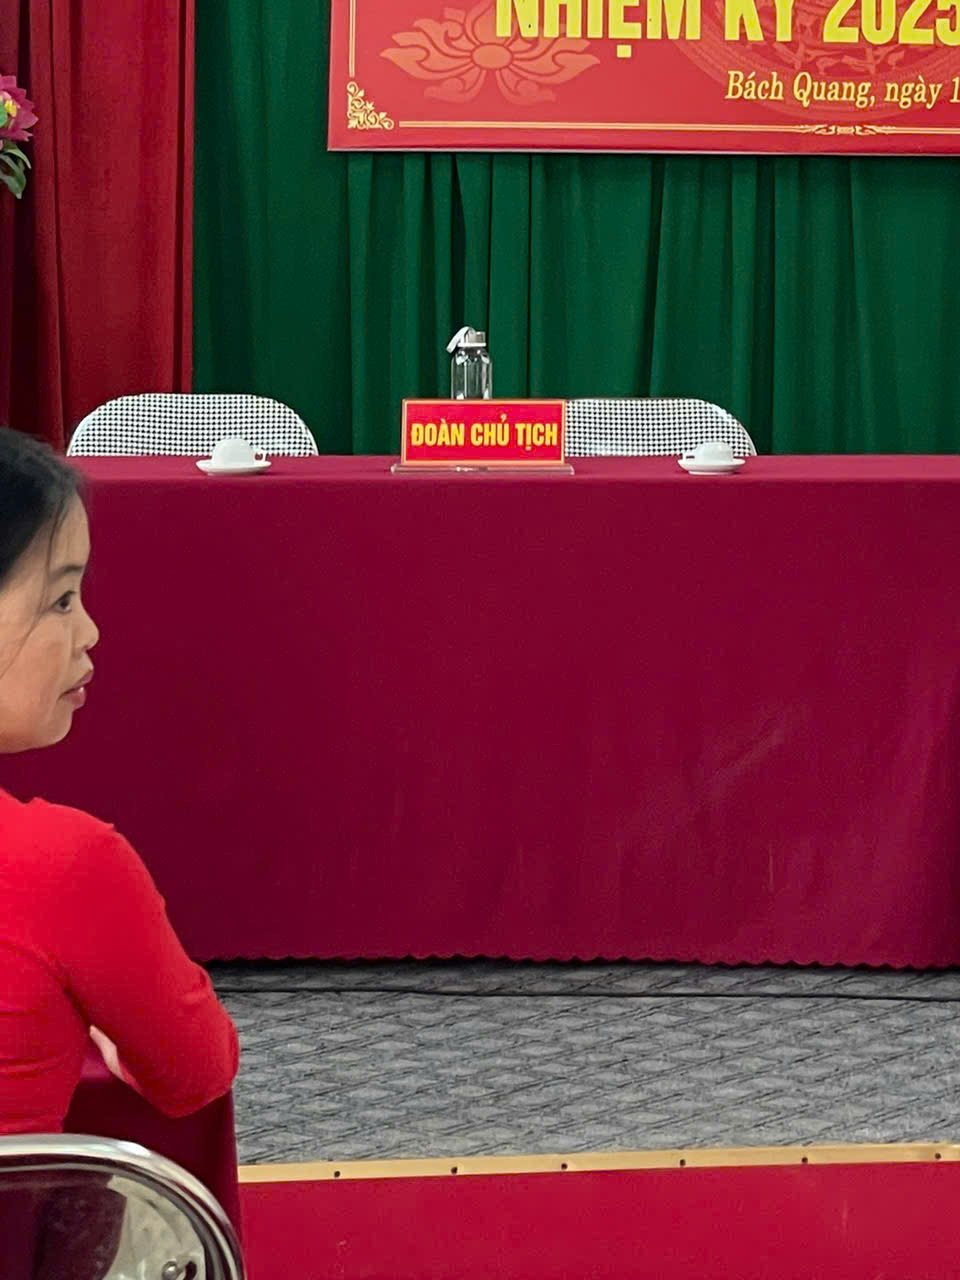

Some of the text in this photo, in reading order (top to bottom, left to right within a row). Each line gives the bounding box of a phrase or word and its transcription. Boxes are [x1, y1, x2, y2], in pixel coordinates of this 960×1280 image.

[725, 71, 783, 100] Bách
[794, 72, 875, 108] Quang,
[884, 75, 942, 109] ngày
[411, 414, 557, 450] ĐOÀN CHỦ TỊCH
